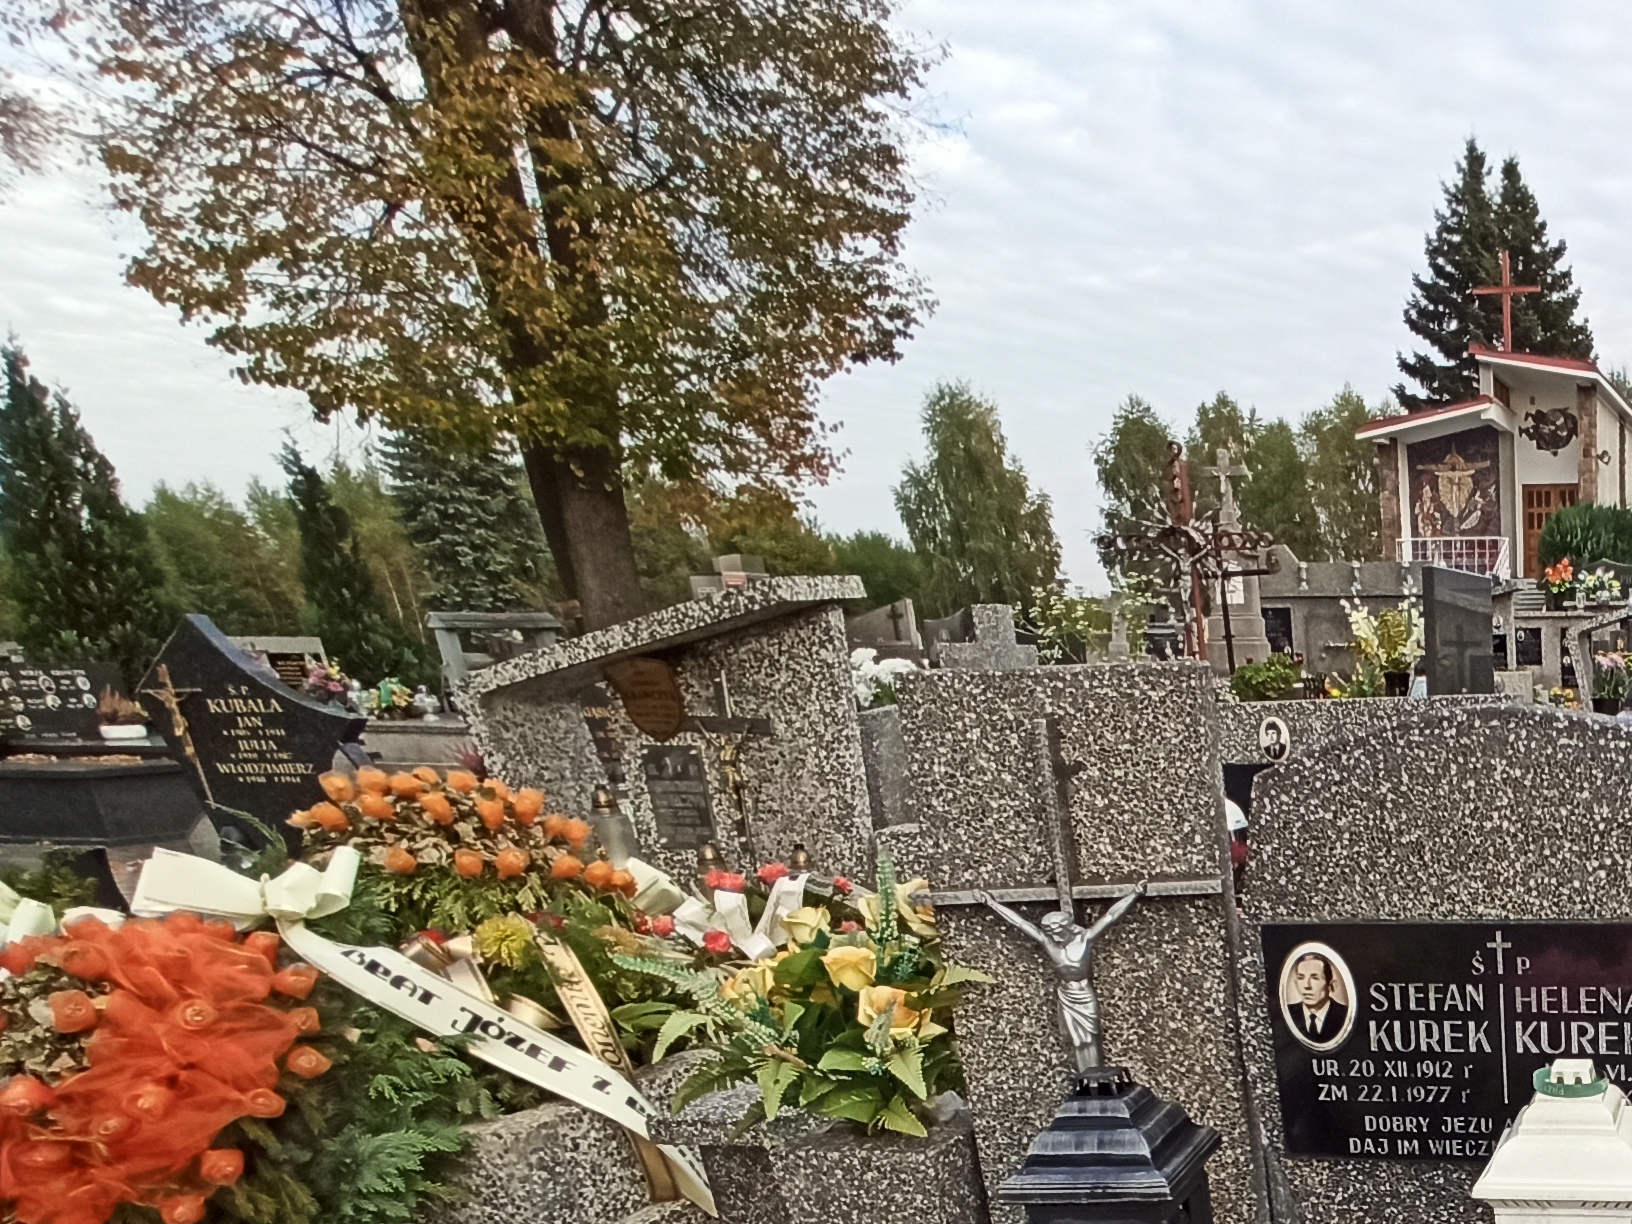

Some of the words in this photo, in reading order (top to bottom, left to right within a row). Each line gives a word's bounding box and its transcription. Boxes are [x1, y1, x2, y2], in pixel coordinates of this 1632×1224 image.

[206, 698, 284, 714] KUBALA
[236, 716, 264, 728] JAN
[238, 739, 278, 752] JULIA
[340, 949, 443, 1006] BRAT
[1369, 982, 1484, 1012] STEFAN
[1368, 1019, 1493, 1053] KUREK
[1364, 1115, 1430, 1133] DOBRY
[1441, 1116, 1493, 1134] JEZU
[1349, 1137, 1389, 1155] DAJ
[1397, 1139, 1420, 1155] IM
[1428, 1139, 1498, 1156] WIECZ
